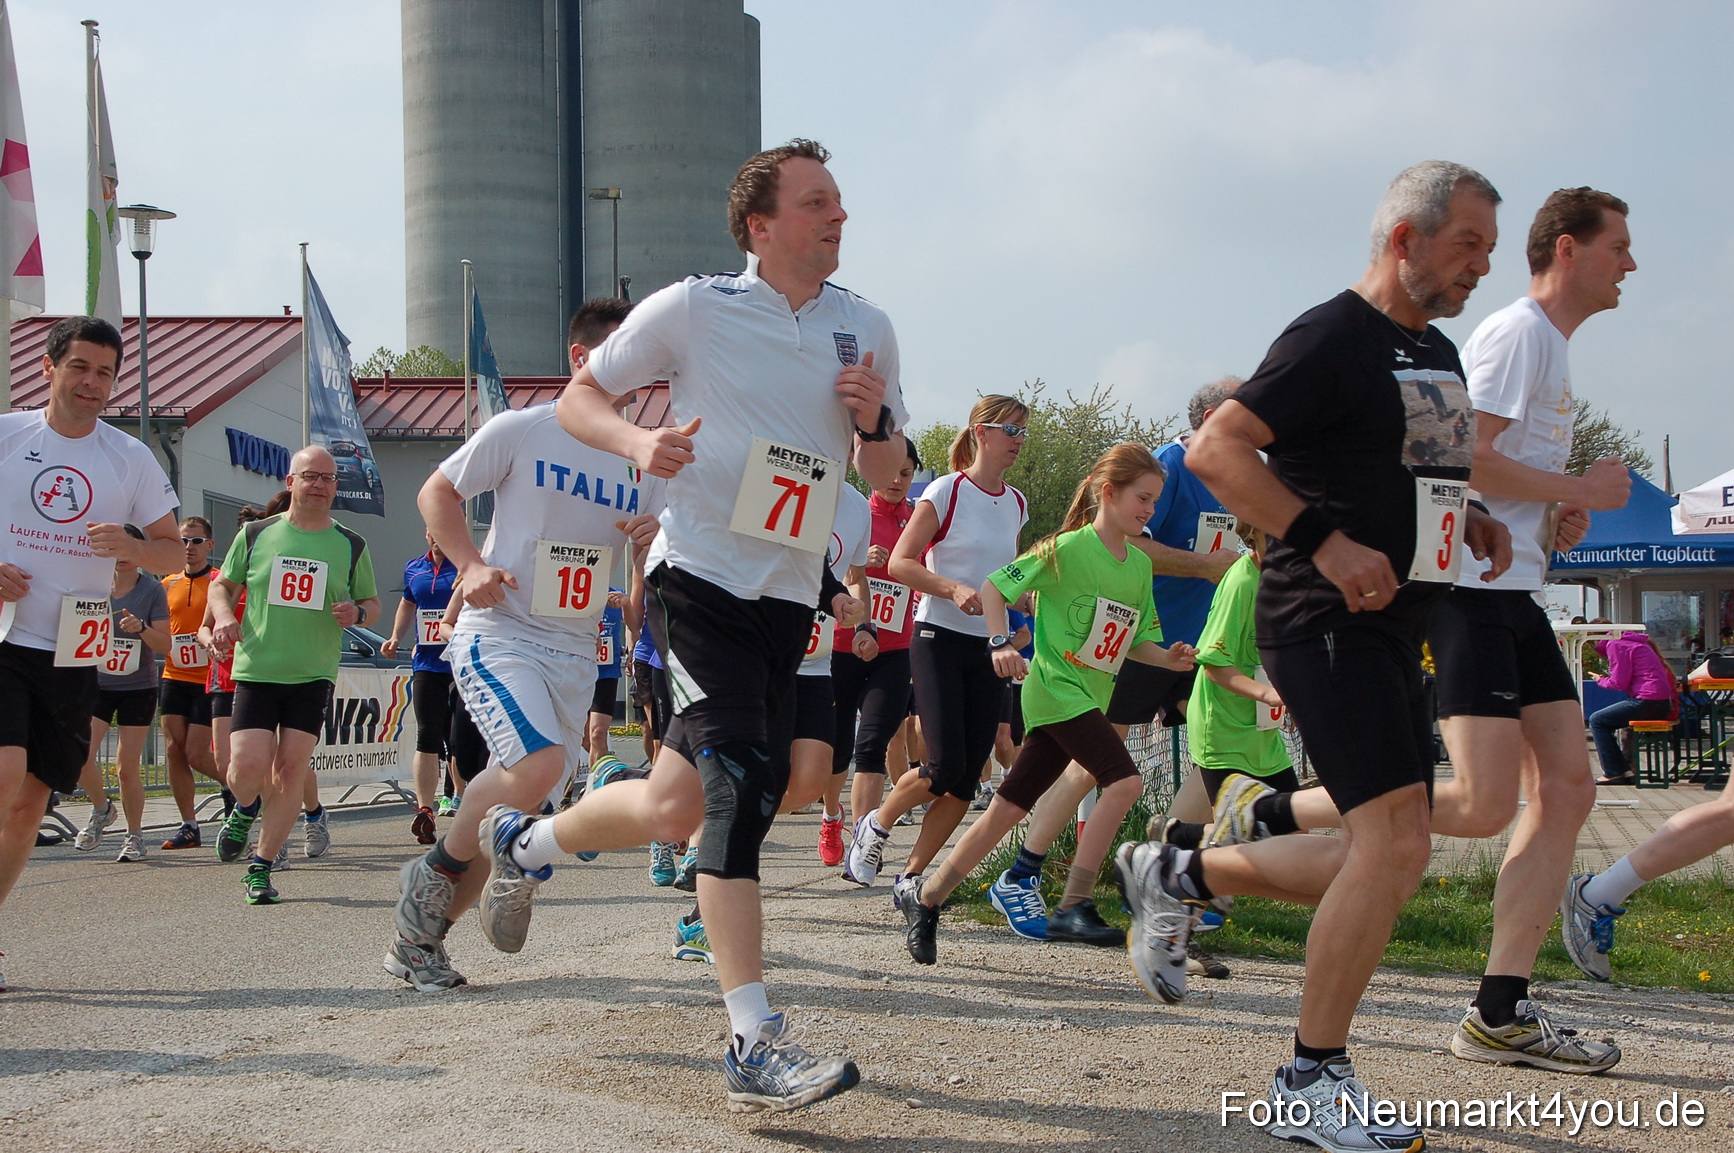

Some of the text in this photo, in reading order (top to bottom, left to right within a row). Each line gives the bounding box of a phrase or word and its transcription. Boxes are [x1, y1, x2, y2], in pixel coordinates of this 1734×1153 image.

[225, 427, 291, 480] VOLVO
[767, 444, 811, 467] MEYER
[766, 456, 810, 476] WERBUNG
[536, 459, 639, 516] ITALIA
[764, 474, 811, 538] 71
[1205, 515, 1228, 524] MEYER
[16, 540, 28, 548] Dr.
[29, 542, 48, 552] Heck
[55, 547, 67, 555] Dr.
[53, 534, 74, 545] MIT
[1437, 511, 1455, 571] 3
[549, 554, 585, 564] WERBUNG
[550, 545, 585, 557] MEYER
[1556, 545, 1716, 564] Neumarkter Tagblatt
[281, 558, 308, 567] MEYER
[280, 572, 315, 603] 69
[557, 565, 593, 610] 19
[869, 580, 893, 591] MEYER
[871, 593, 896, 624] 16
[1106, 603, 1131, 618] MEYER
[75, 617, 110, 658] 23
[424, 621, 442, 642] 72
[1094, 621, 1129, 664] 34
[180, 645, 198, 665] 61
[309, 753, 354, 771] adtwerke
